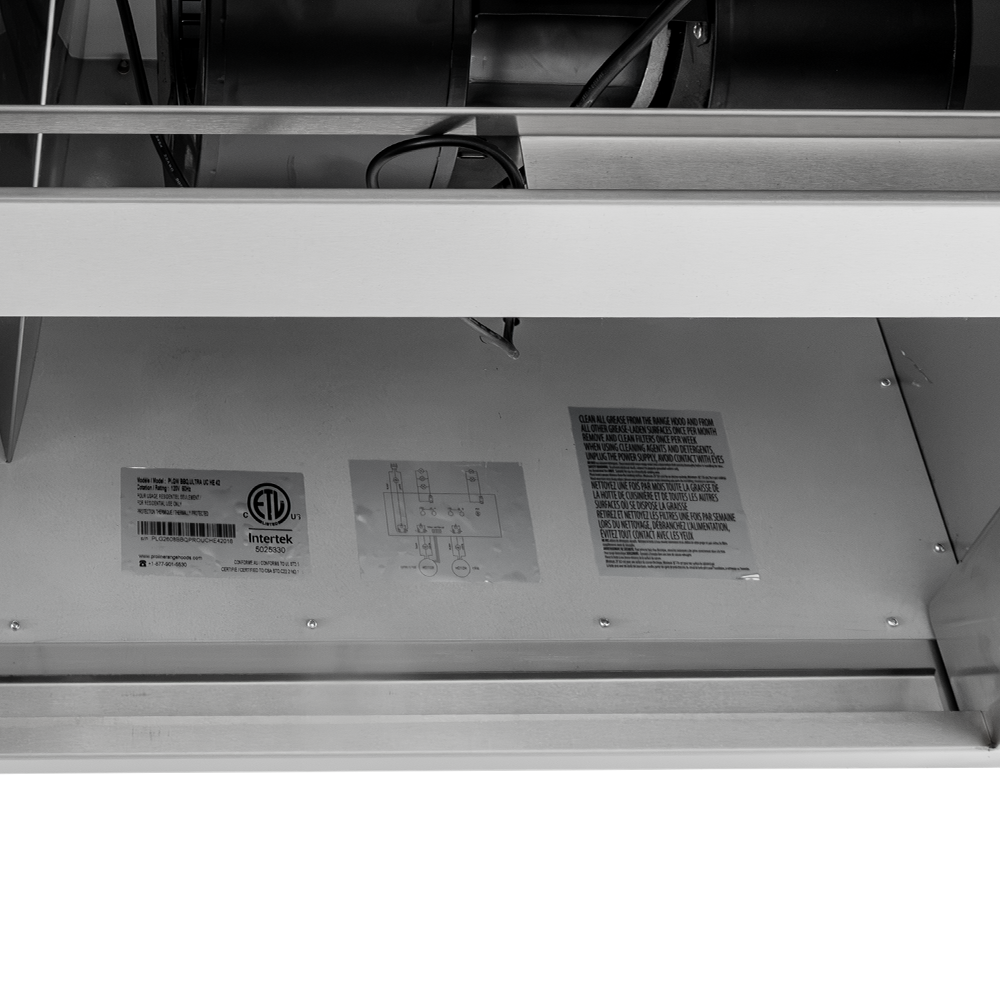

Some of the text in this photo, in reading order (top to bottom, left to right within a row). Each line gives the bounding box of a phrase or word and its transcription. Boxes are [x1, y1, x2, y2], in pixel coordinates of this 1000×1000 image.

[579, 415, 714, 427] CLEAN ALL GREASE FROM THE RANGE HOOD AND FROM
[581, 424, 718, 436] ALL OTHER GREASE-LADEN SURFACES ONCE PER MONTH
[582, 433, 698, 444] REMOVE AND CLEAN FILTERS ONCE PER WEEK
[584, 443, 715, 456] WHEN USING CLEANING AGENTS AND DETERGENTS,
[586, 452, 725, 464] UNPLUG THE POWER SUPPLY, AVOID CONTACT WITH EYES
[591, 481, 617, 490] NETTOYEZ
[617, 481, 628, 490] UNE
[628, 481, 641, 490] FOIS
[641, 482, 652, 491] PAR
[652, 482, 666, 491] MOIS
[666, 483, 682, 491] TOUTE
[682, 483, 690, 491] LA
[690, 484, 713, 493] GRAISSE
[712, 484, 720, 493] DE
[593, 490, 600, 499] LA
[600, 490, 617, 499] HOTTE
[654, 492, 661, 500] ET
[660, 492, 669, 500] DE
[669, 492, 688, 501] TOUTES
[688, 493, 698, 502] LES
[698, 493, 719, 502] AUTRES
[594, 500, 620, 509] SURFACES
[629, 500, 636, 509] SE
[636, 501, 658, 510] DISPOSE
[658, 501, 666, 510] LA
[666, 502, 689, 511] GRAISSE
[596, 510, 737, 522] RETIREZ ET NETTOYEZ LES FILTRES UNE FOIS PAR SEMAINE
[598, 519, 611, 528] LORS
[611, 520, 620, 529] DU
[620, 520, 652, 531] NETTOYAGE,
[248, 532, 293, 545] Intertek
[617, 530, 632, 539] TOUT
[632, 530, 656, 539] CONTACT
[656, 531, 671, 540] AVEC
[670, 531, 680, 540] LES
[680, 531, 695, 541] YEUX
[255, 546, 287, 554] 5025330
